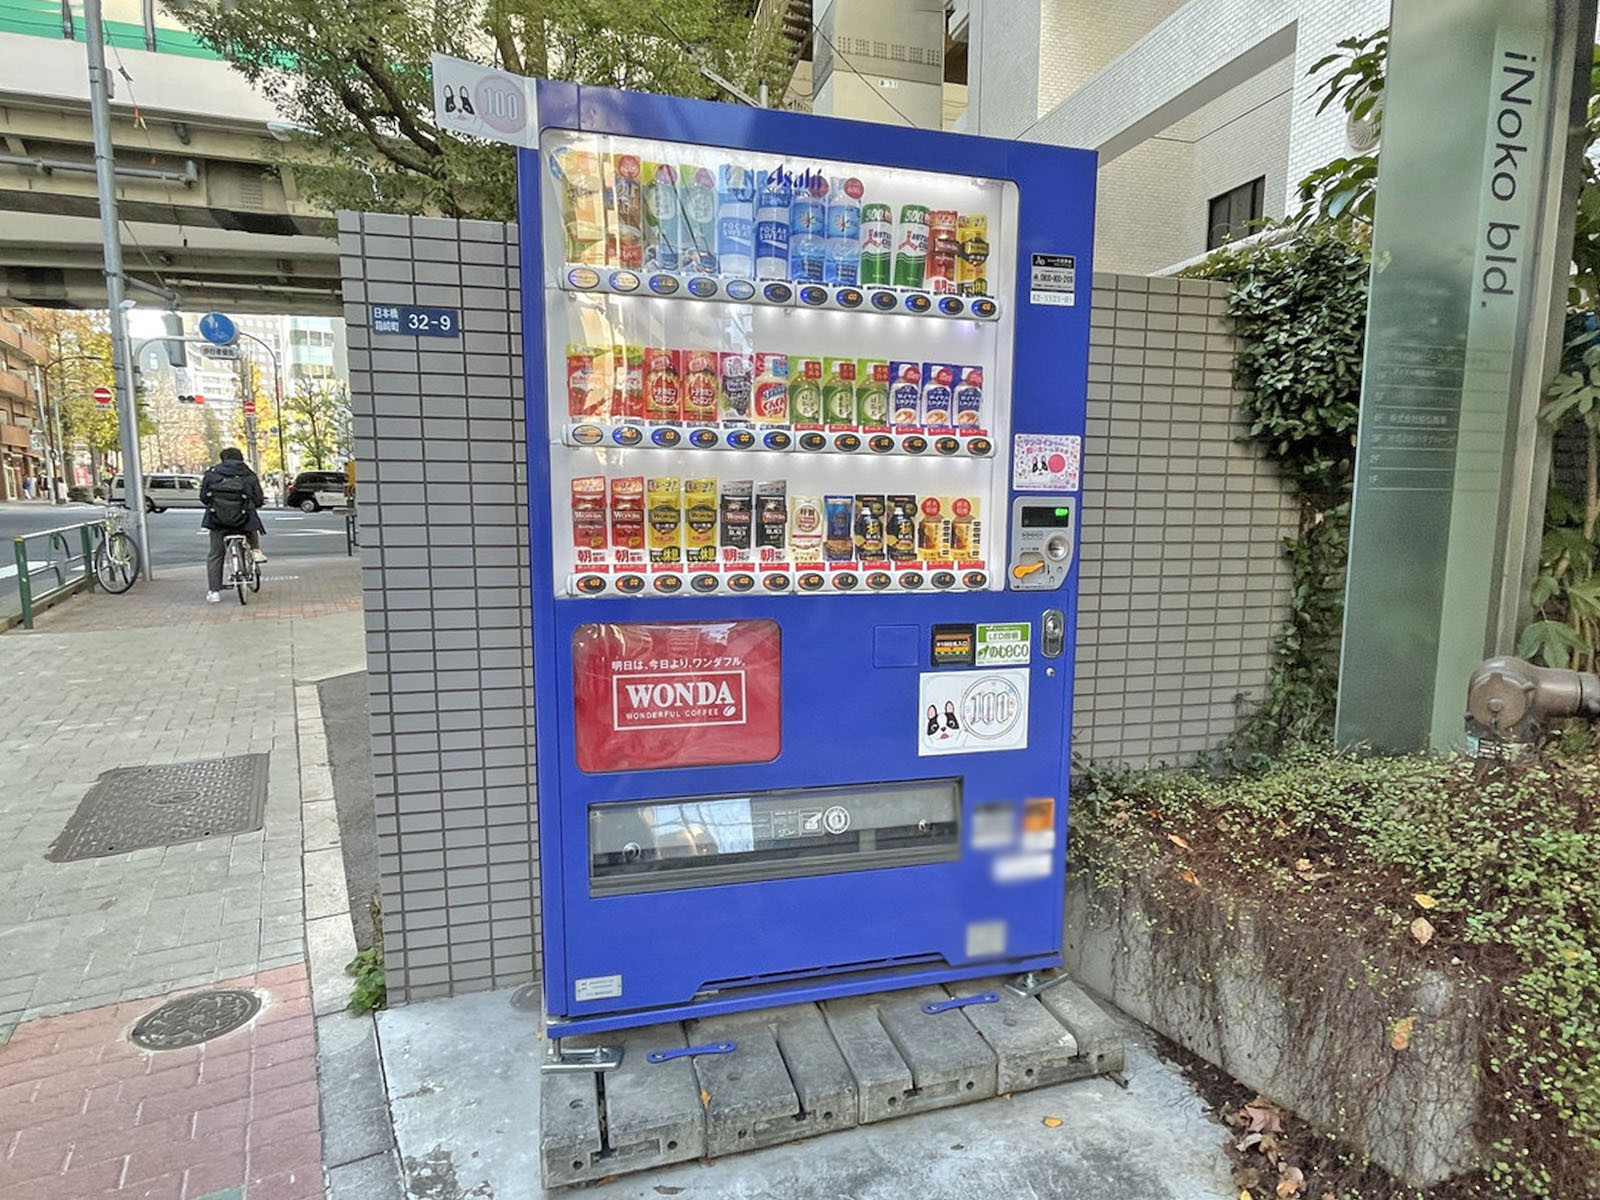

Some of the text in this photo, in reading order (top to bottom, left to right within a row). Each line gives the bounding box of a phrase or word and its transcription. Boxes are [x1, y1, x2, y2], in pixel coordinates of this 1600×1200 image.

[484, 87, 518, 121] 100
[767, 164, 822, 190] Asahi
[1480, 51, 1537, 308] iNoko bld.
[723, 222, 750, 230] POCAR
[760, 225, 787, 234] POCAR
[408, 313, 451, 331] 32-9
[626, 680, 735, 709] WONDA
[626, 708, 719, 720] WONDERFUL COFFEE
[970, 691, 1010, 725] 100
